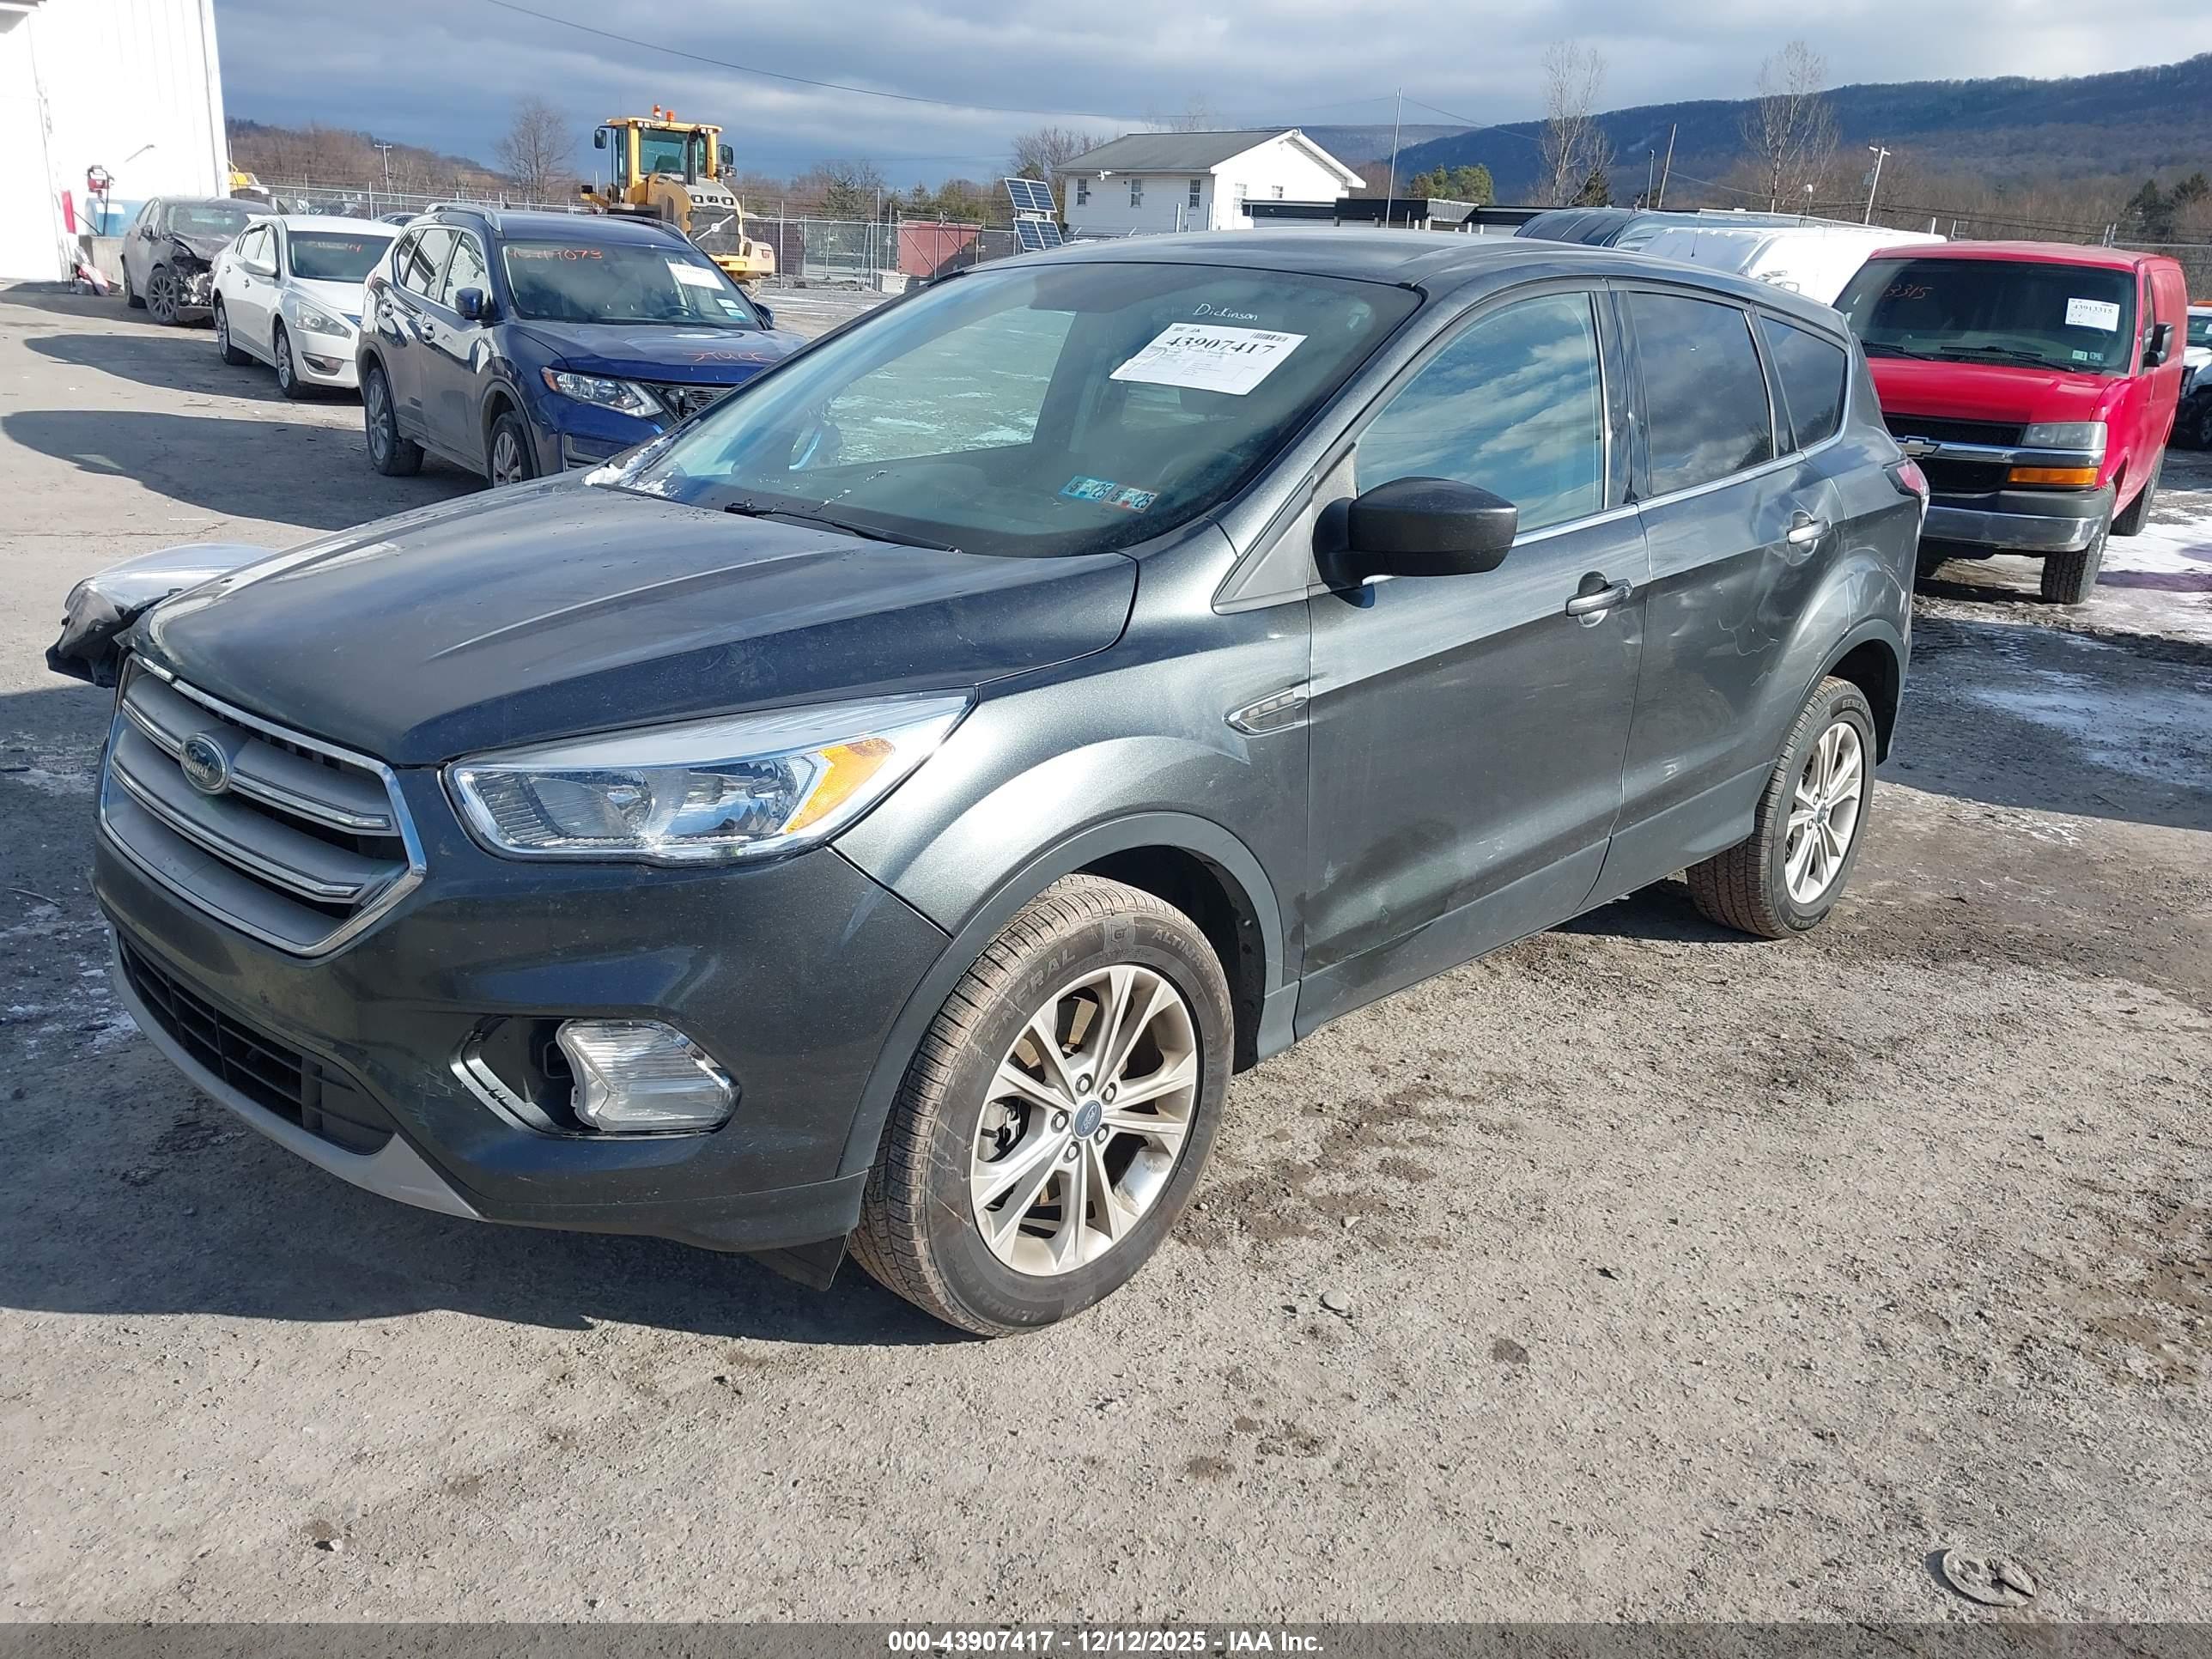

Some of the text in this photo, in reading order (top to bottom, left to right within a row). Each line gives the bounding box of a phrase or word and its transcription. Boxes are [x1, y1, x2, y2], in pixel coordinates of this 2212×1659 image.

[1193, 303, 1259, 321] Dickinson
[1166, 336, 1277, 355] 43907417
[1091, 483, 1112, 499] 25
[1111, 489, 1155, 509] 5 25
